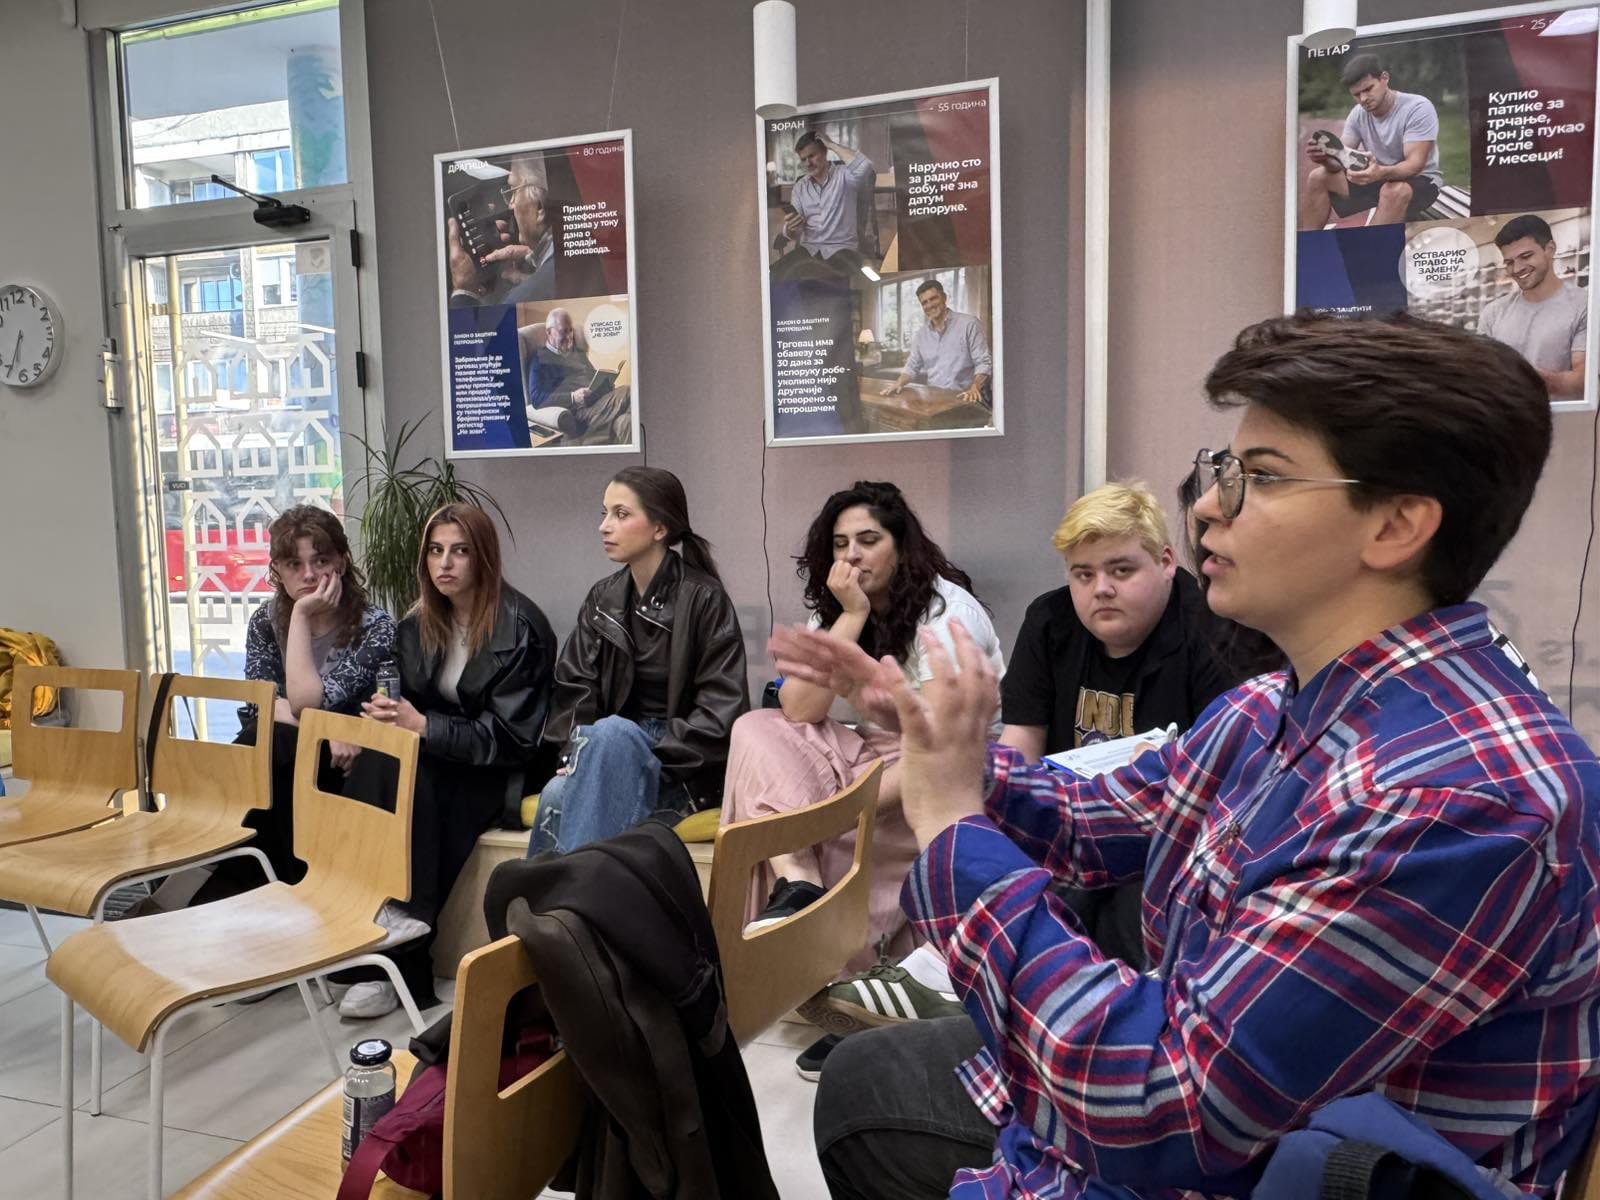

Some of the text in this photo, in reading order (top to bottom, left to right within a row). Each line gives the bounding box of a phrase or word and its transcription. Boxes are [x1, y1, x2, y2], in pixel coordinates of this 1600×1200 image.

[1530, 18, 1546, 30] 25
[1488, 89, 1538, 105] Купио
[938, 99, 987, 112] 55 година
[1488, 99, 1565, 117] патике за
[771, 120, 805, 132] ЗОРАН
[1487, 114, 1552, 130] трчање,
[1487, 122, 1586, 144] ђон је пукао
[584, 144, 625, 157] 80 година
[1486, 140, 1534, 154] после
[1486, 148, 1564, 167] 7 месеци!
[909, 158, 982, 175] Наручио сто
[908, 171, 960, 186] за радну
[908, 180, 978, 195] собу, не зна
[908, 196, 944, 206] датум
[562, 202, 606, 214] Примио 10
[908, 203, 968, 216] испоруке.
[563, 210, 618, 223] телефонских
[564, 218, 619, 231] позива у току
[564, 232, 584, 240] дана
[564, 238, 597, 249] продаји
[564, 246, 610, 256] производа.
[1412, 249, 1467, 261] ОСТВАРИО
[1414, 257, 1465, 268] ПРАВО НА
[1418, 264, 1460, 274] ЗАМЕНУ
[1425, 274, 1452, 282] РОБЕ
[10, 289, 24, 304] 12
[29, 294, 36, 308] 1
[40, 306, 49, 322] 2
[777, 339, 834, 350] Трговац има
[42, 346, 50, 360] 4
[777, 348, 828, 359] обавезу од
[777, 358, 824, 368] 30 дана за
[4, 364, 13, 378] 7
[18, 368, 28, 384] 6
[33, 362, 42, 378] 5
[777, 367, 820, 378] испоруку
[822, 366, 845, 376] робе
[778, 375, 838, 388] уколико није
[778, 386, 823, 398] другачије
[778, 395, 838, 407] уговорено са
[778, 404, 836, 415] потрошачем
